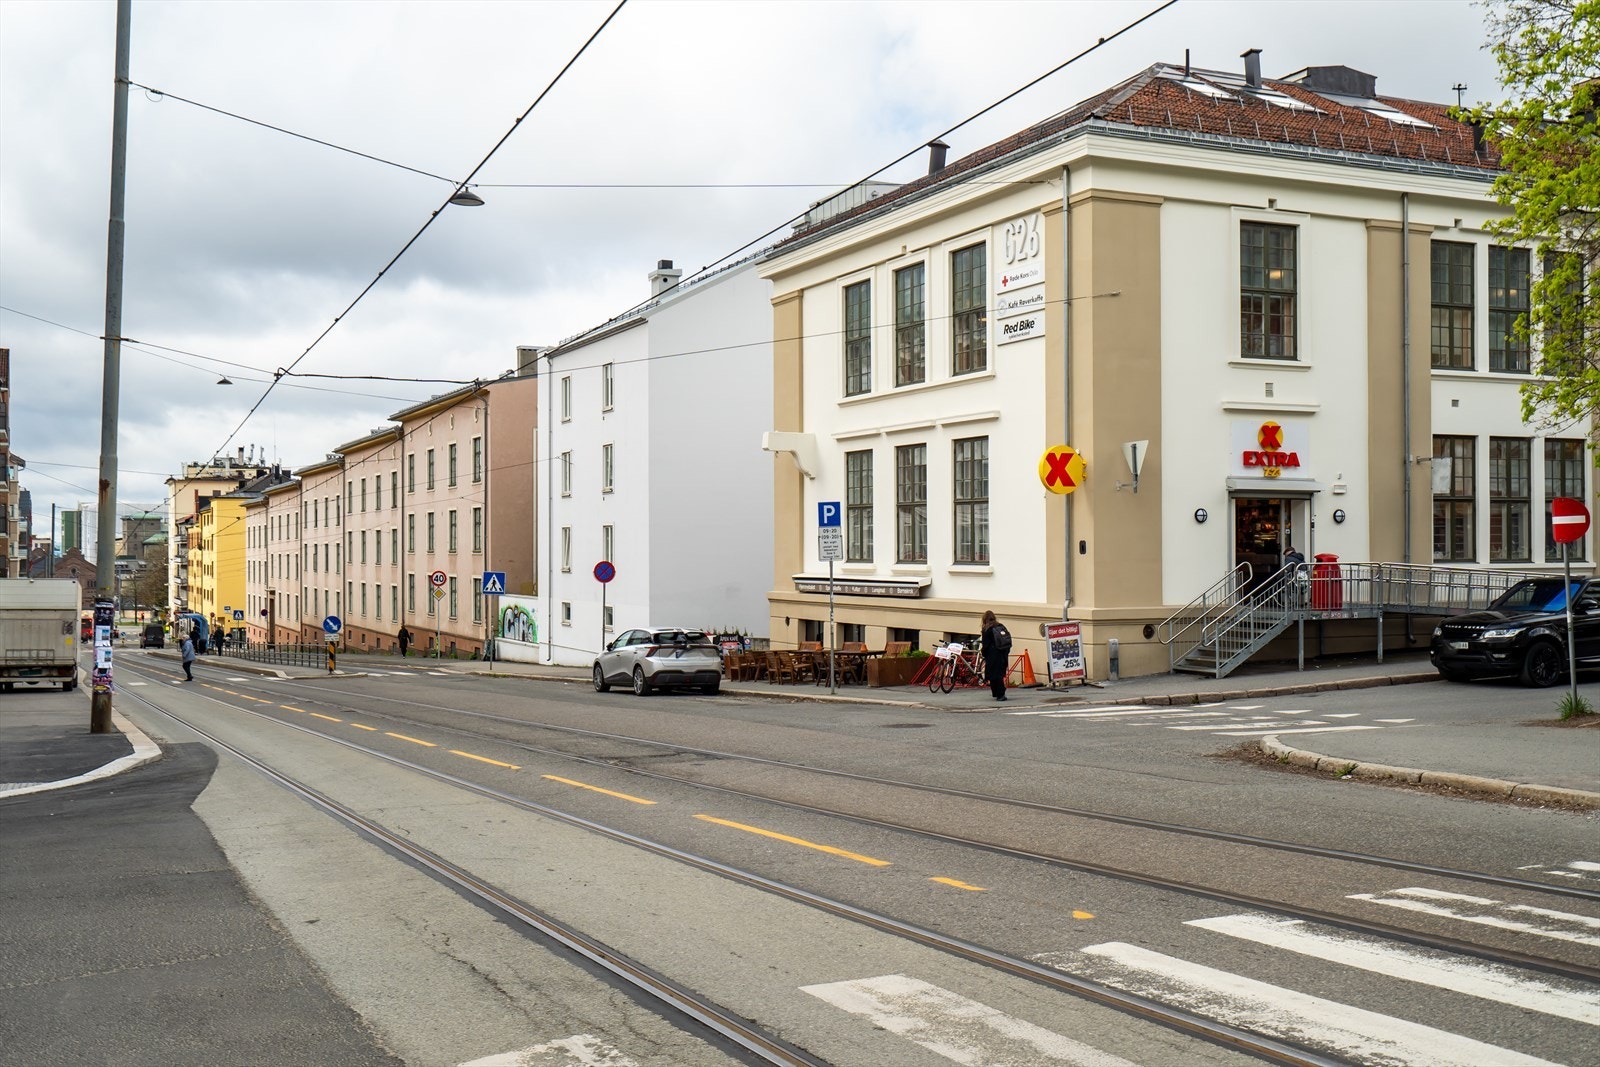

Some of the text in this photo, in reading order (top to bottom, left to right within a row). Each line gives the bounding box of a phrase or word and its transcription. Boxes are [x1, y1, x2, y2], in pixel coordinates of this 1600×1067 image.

[1003, 319, 1035, 334] Red Bike
[1243, 451, 1300, 467] EXTRA
[1045, 452, 1077, 486] X
[823, 505, 835, 524] P
[1063, 658, 1080, 669] -25%
